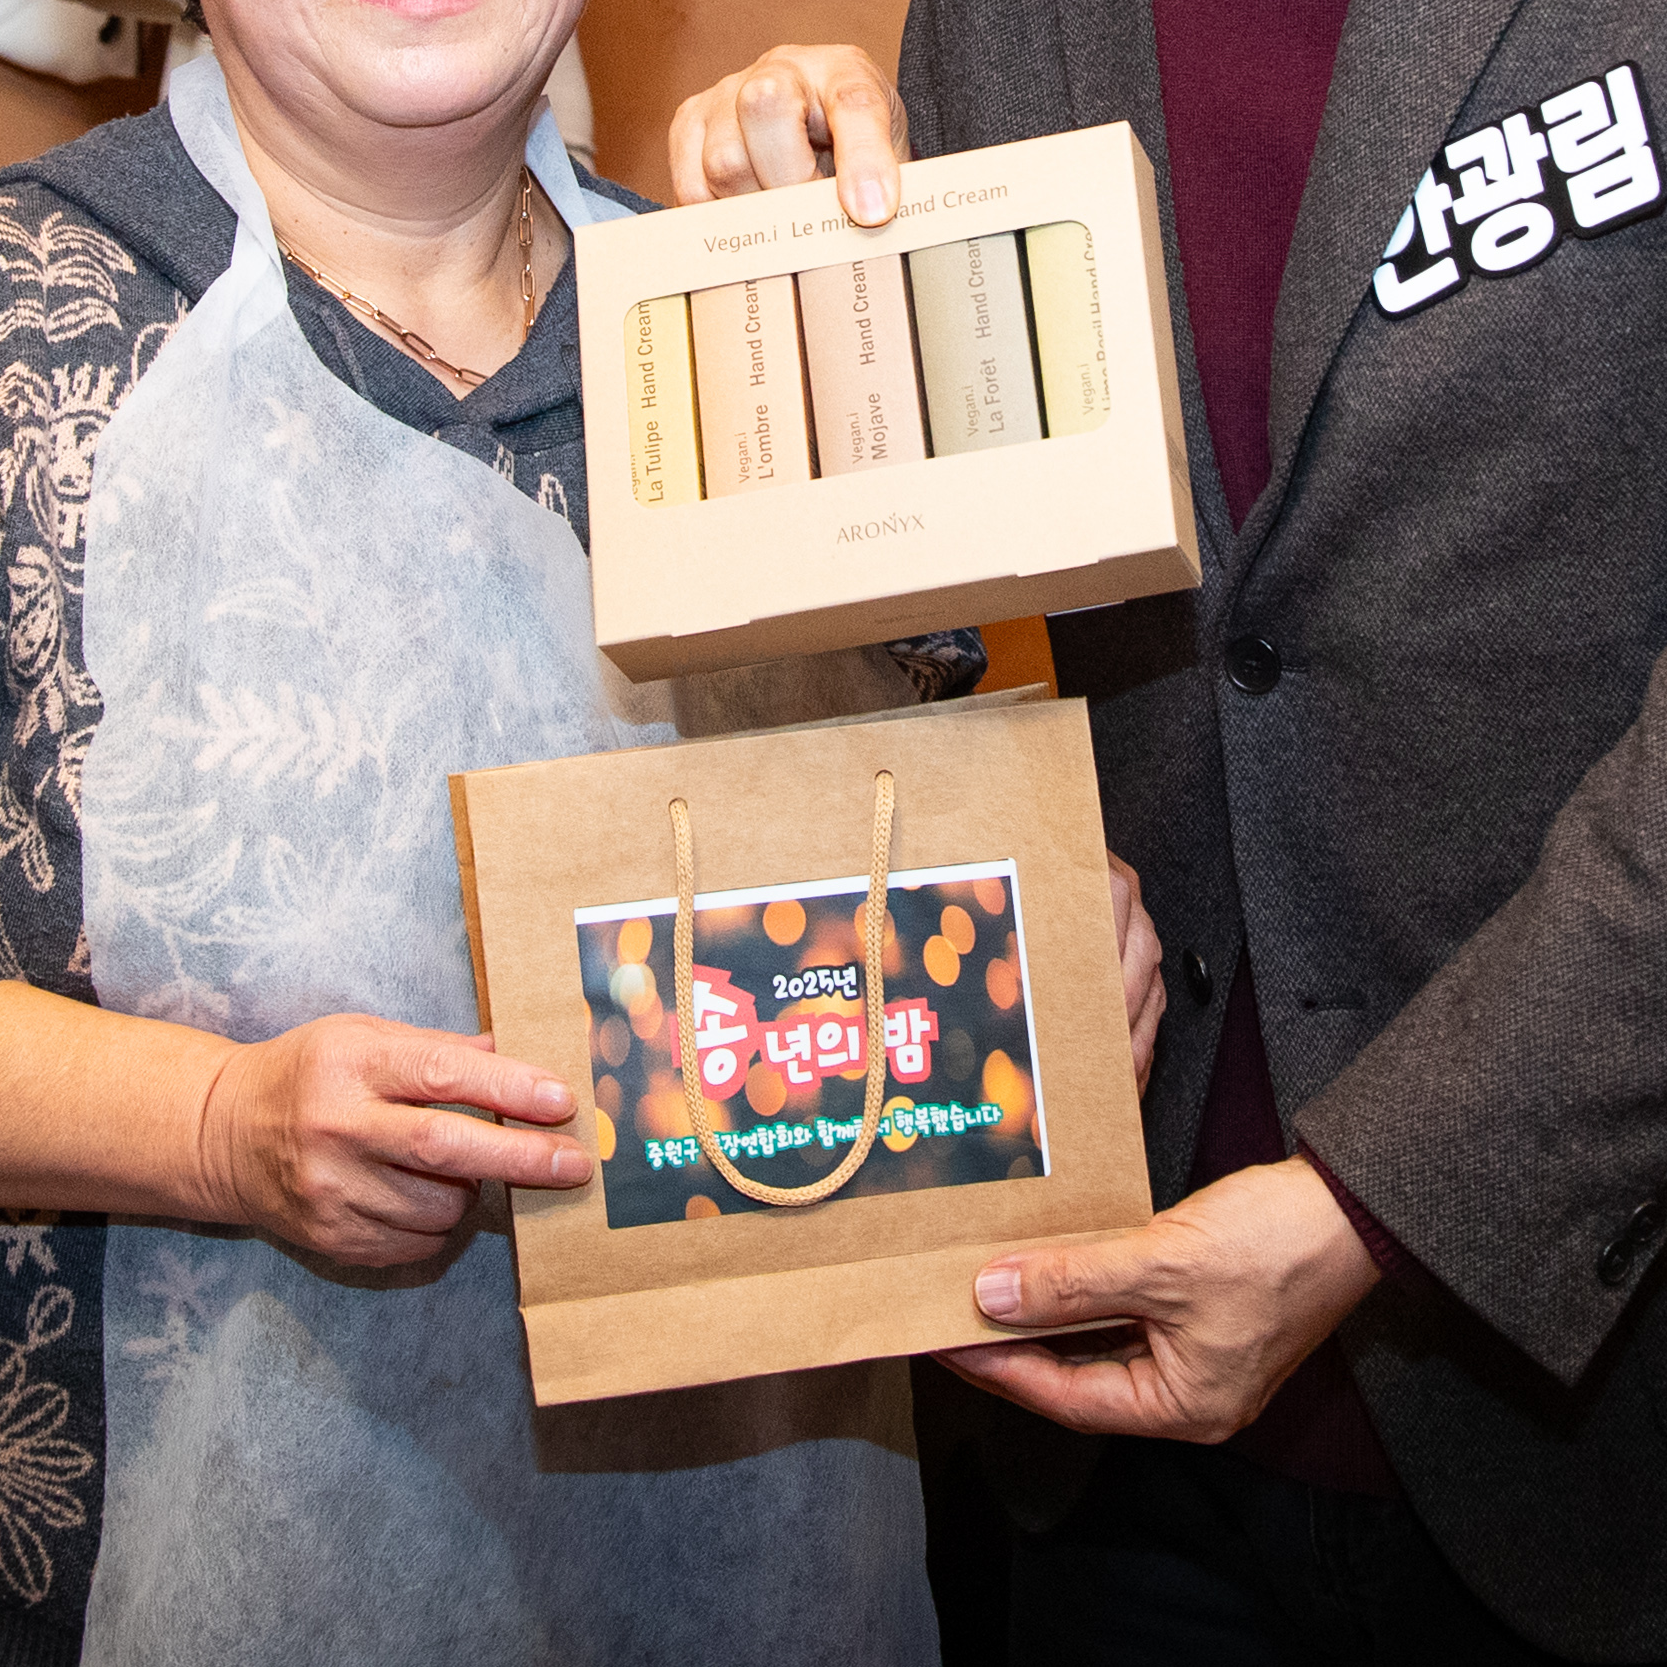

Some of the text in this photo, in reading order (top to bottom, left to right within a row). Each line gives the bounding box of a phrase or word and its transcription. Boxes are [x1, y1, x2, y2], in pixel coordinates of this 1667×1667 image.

[1373, 65, 1661, 313] 안광림
[703, 184, 1009, 254] Vegan.i Le mie and Cream
[856, 317, 876, 366] Hand
[970, 292, 992, 339] Hand
[746, 338, 766, 387] Hand
[980, 356, 1001, 405] Forêt
[1077, 362, 1095, 416] Vegan.i
[637, 300, 664, 502] La Tulipe Hand Cream
[868, 392, 889, 461] Mojave
[963, 384, 981, 437] Vegan.i
[988, 408, 1005, 434] La
[734, 431, 751, 484] Vegan.i
[753, 404, 774, 480] L'ombre
[846, 411, 864, 465] Vegan.i
[773, 966, 858, 1000] 2025년
[885, 1008, 931, 1074] 밤
[647, 1138, 700, 1168] 중원구
[894, 1104, 1002, 1136] 행복했습니다
